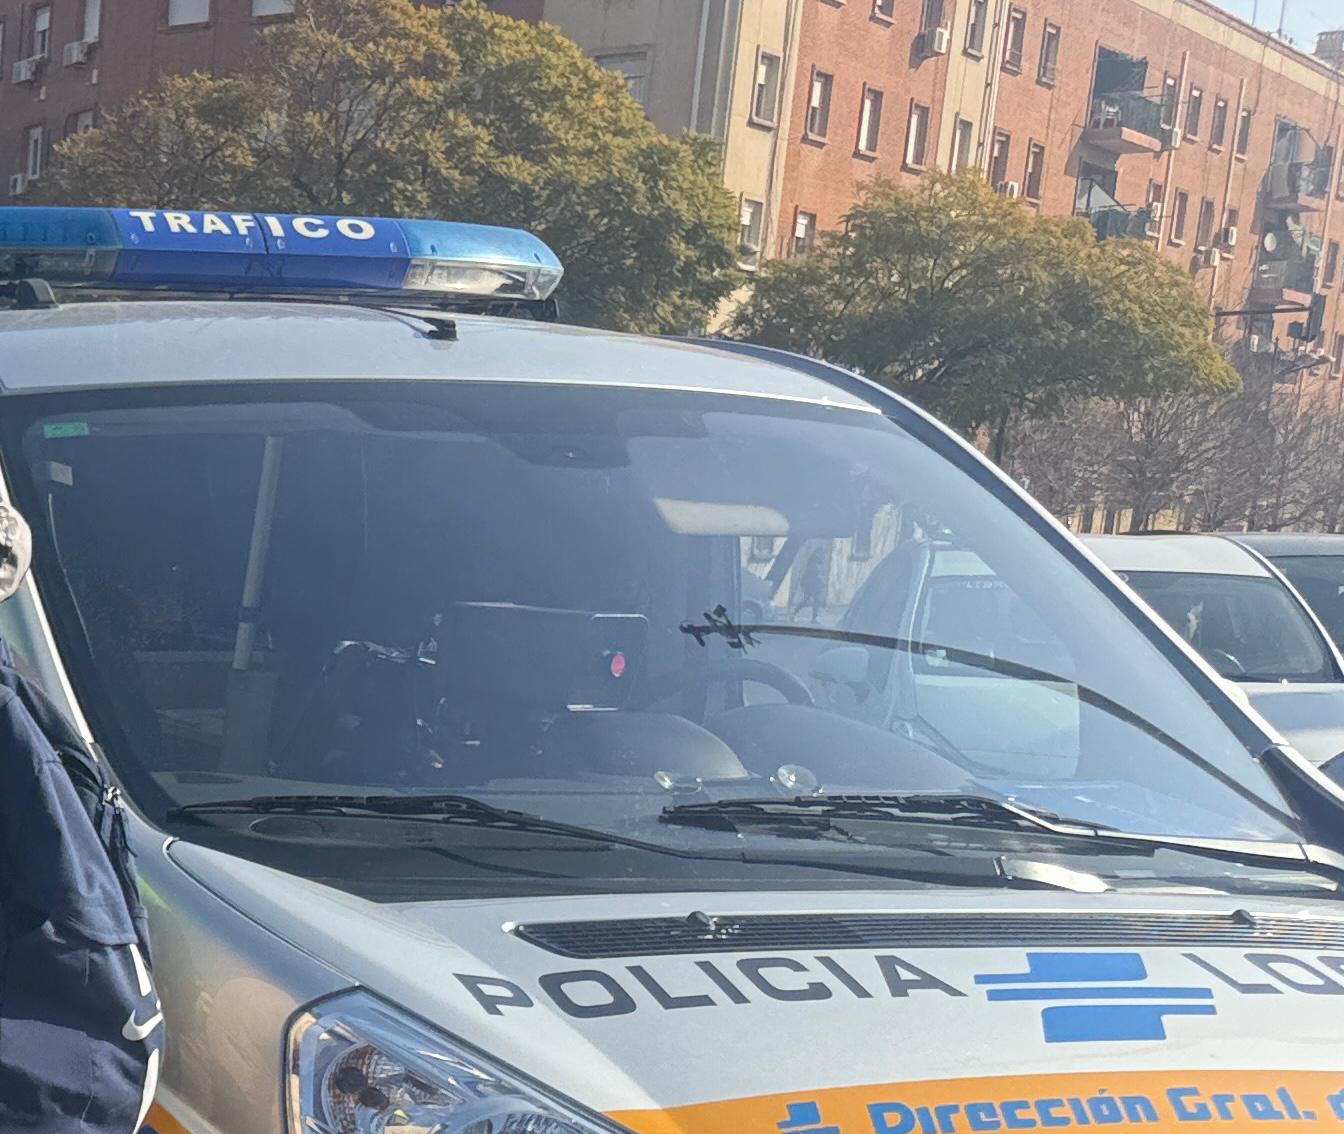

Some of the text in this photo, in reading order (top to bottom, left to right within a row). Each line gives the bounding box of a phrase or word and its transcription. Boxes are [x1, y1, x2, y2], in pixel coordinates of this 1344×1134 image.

[129, 211, 375, 240] TRAFICO
[454, 953, 969, 1019] POLICIA
[1167, 1086, 1317, 1121] Gral.
